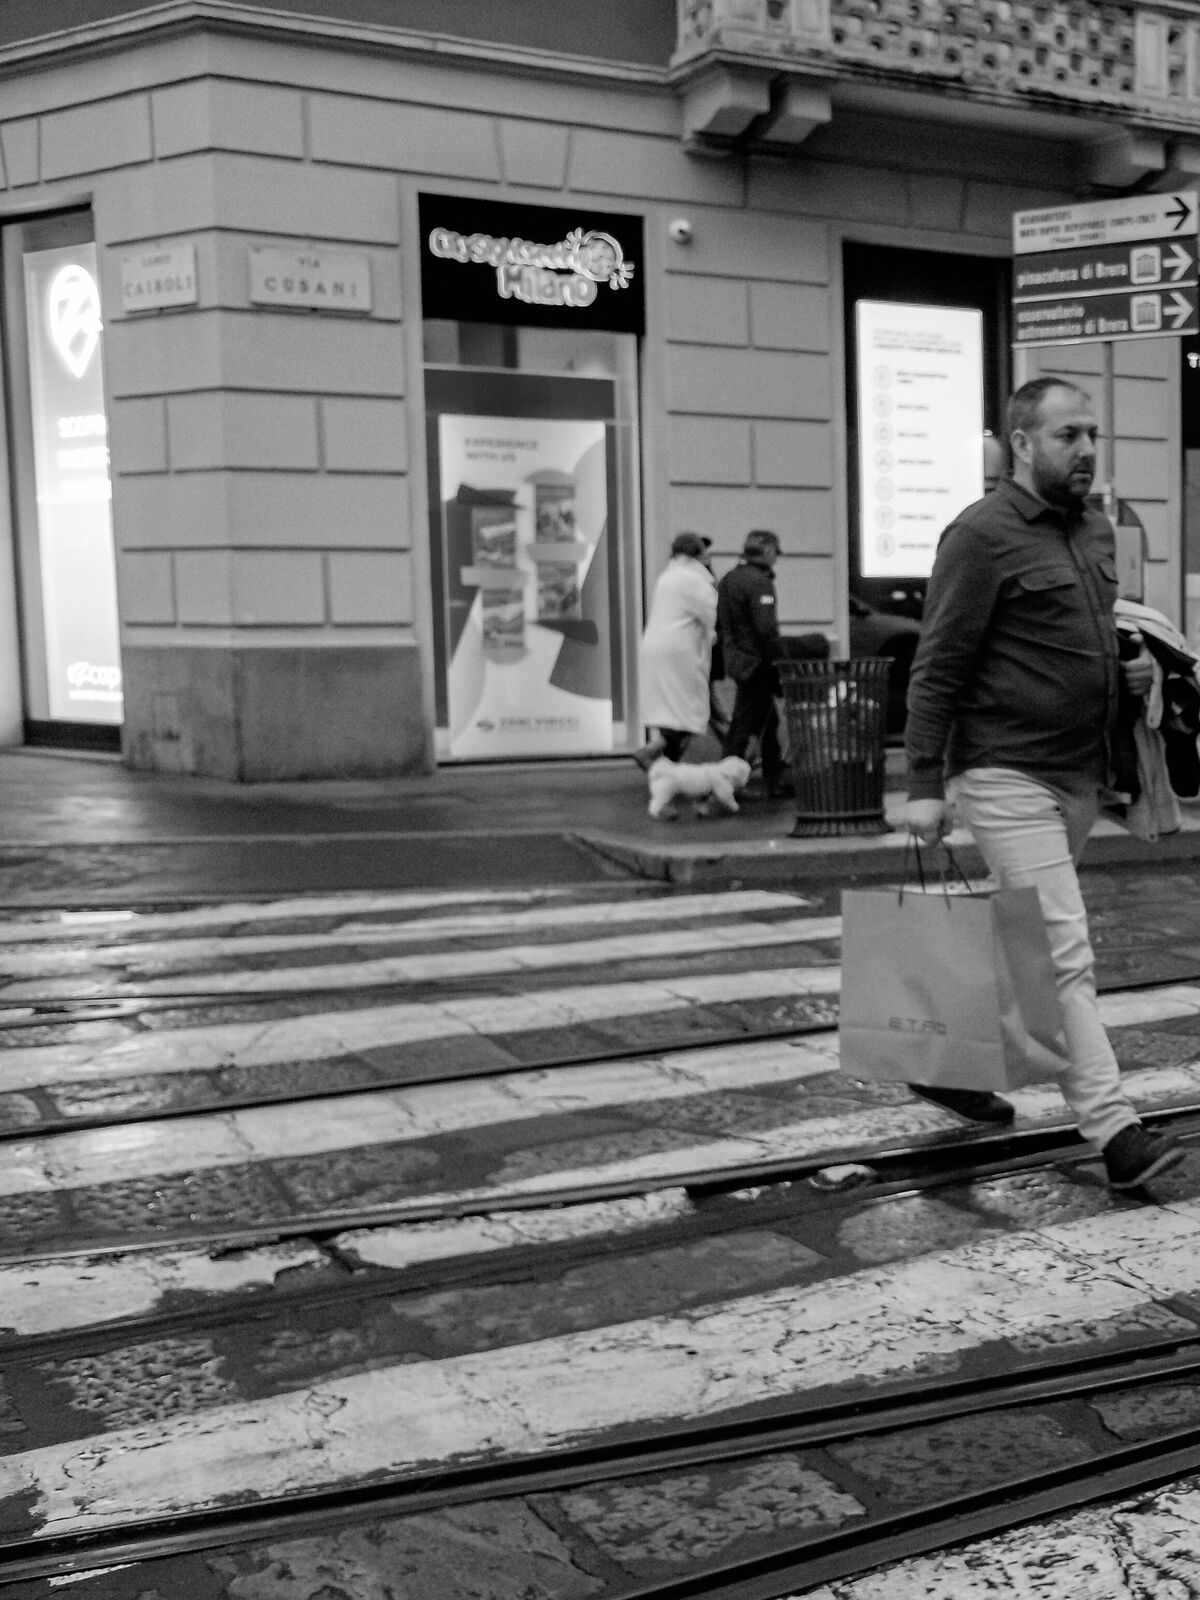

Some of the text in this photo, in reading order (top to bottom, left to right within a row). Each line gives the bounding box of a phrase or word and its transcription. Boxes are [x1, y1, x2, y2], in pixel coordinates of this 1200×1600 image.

[1080, 263, 1094, 279] di
[1095, 262, 1129, 278] Brera
[124, 273, 192, 297] CAIROLI
[1084, 319, 1097, 334] di
[1098, 317, 1129, 333] Brera
